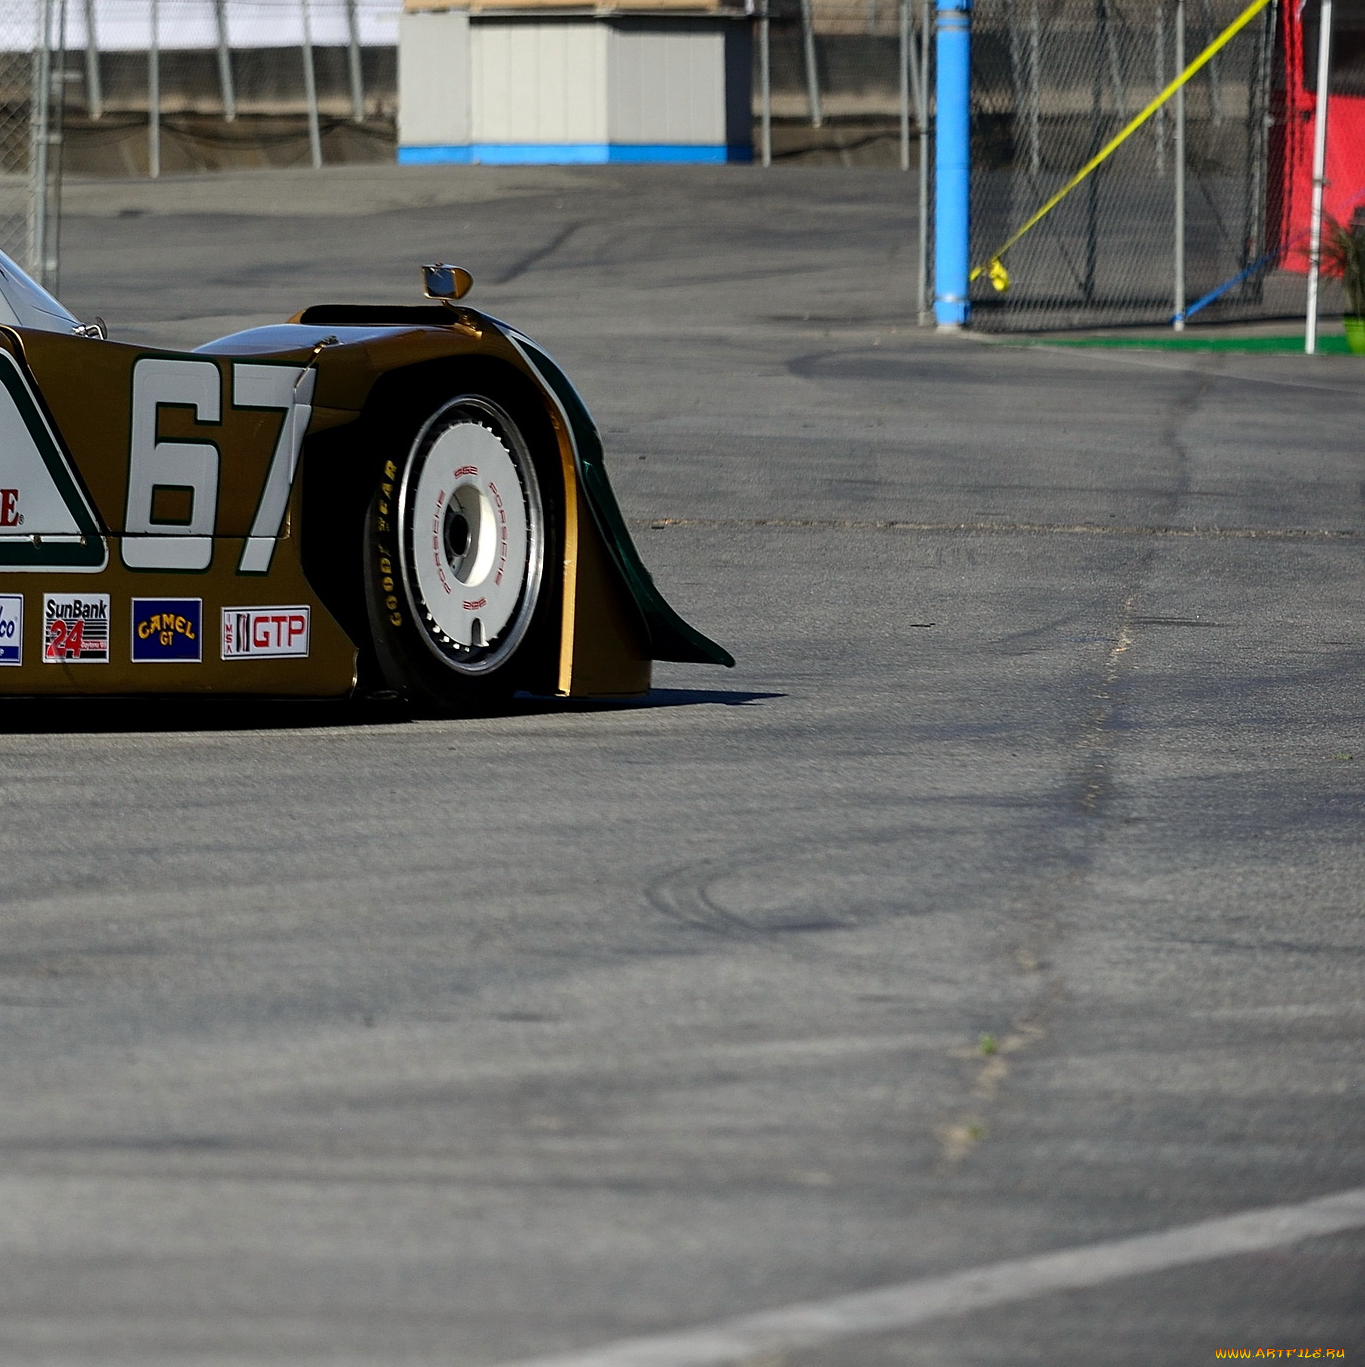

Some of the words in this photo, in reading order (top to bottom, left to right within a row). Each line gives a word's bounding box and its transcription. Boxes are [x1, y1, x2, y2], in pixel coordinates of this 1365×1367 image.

[121, 357, 317, 572] 67
[46, 599, 107, 619] SunBank
[46, 619, 85, 658] 24
[137, 613, 196, 640] CAMEL
[159, 630, 174, 646] GT
[225, 613, 233, 653] IMSA
[253, 615, 306, 647] GTP
